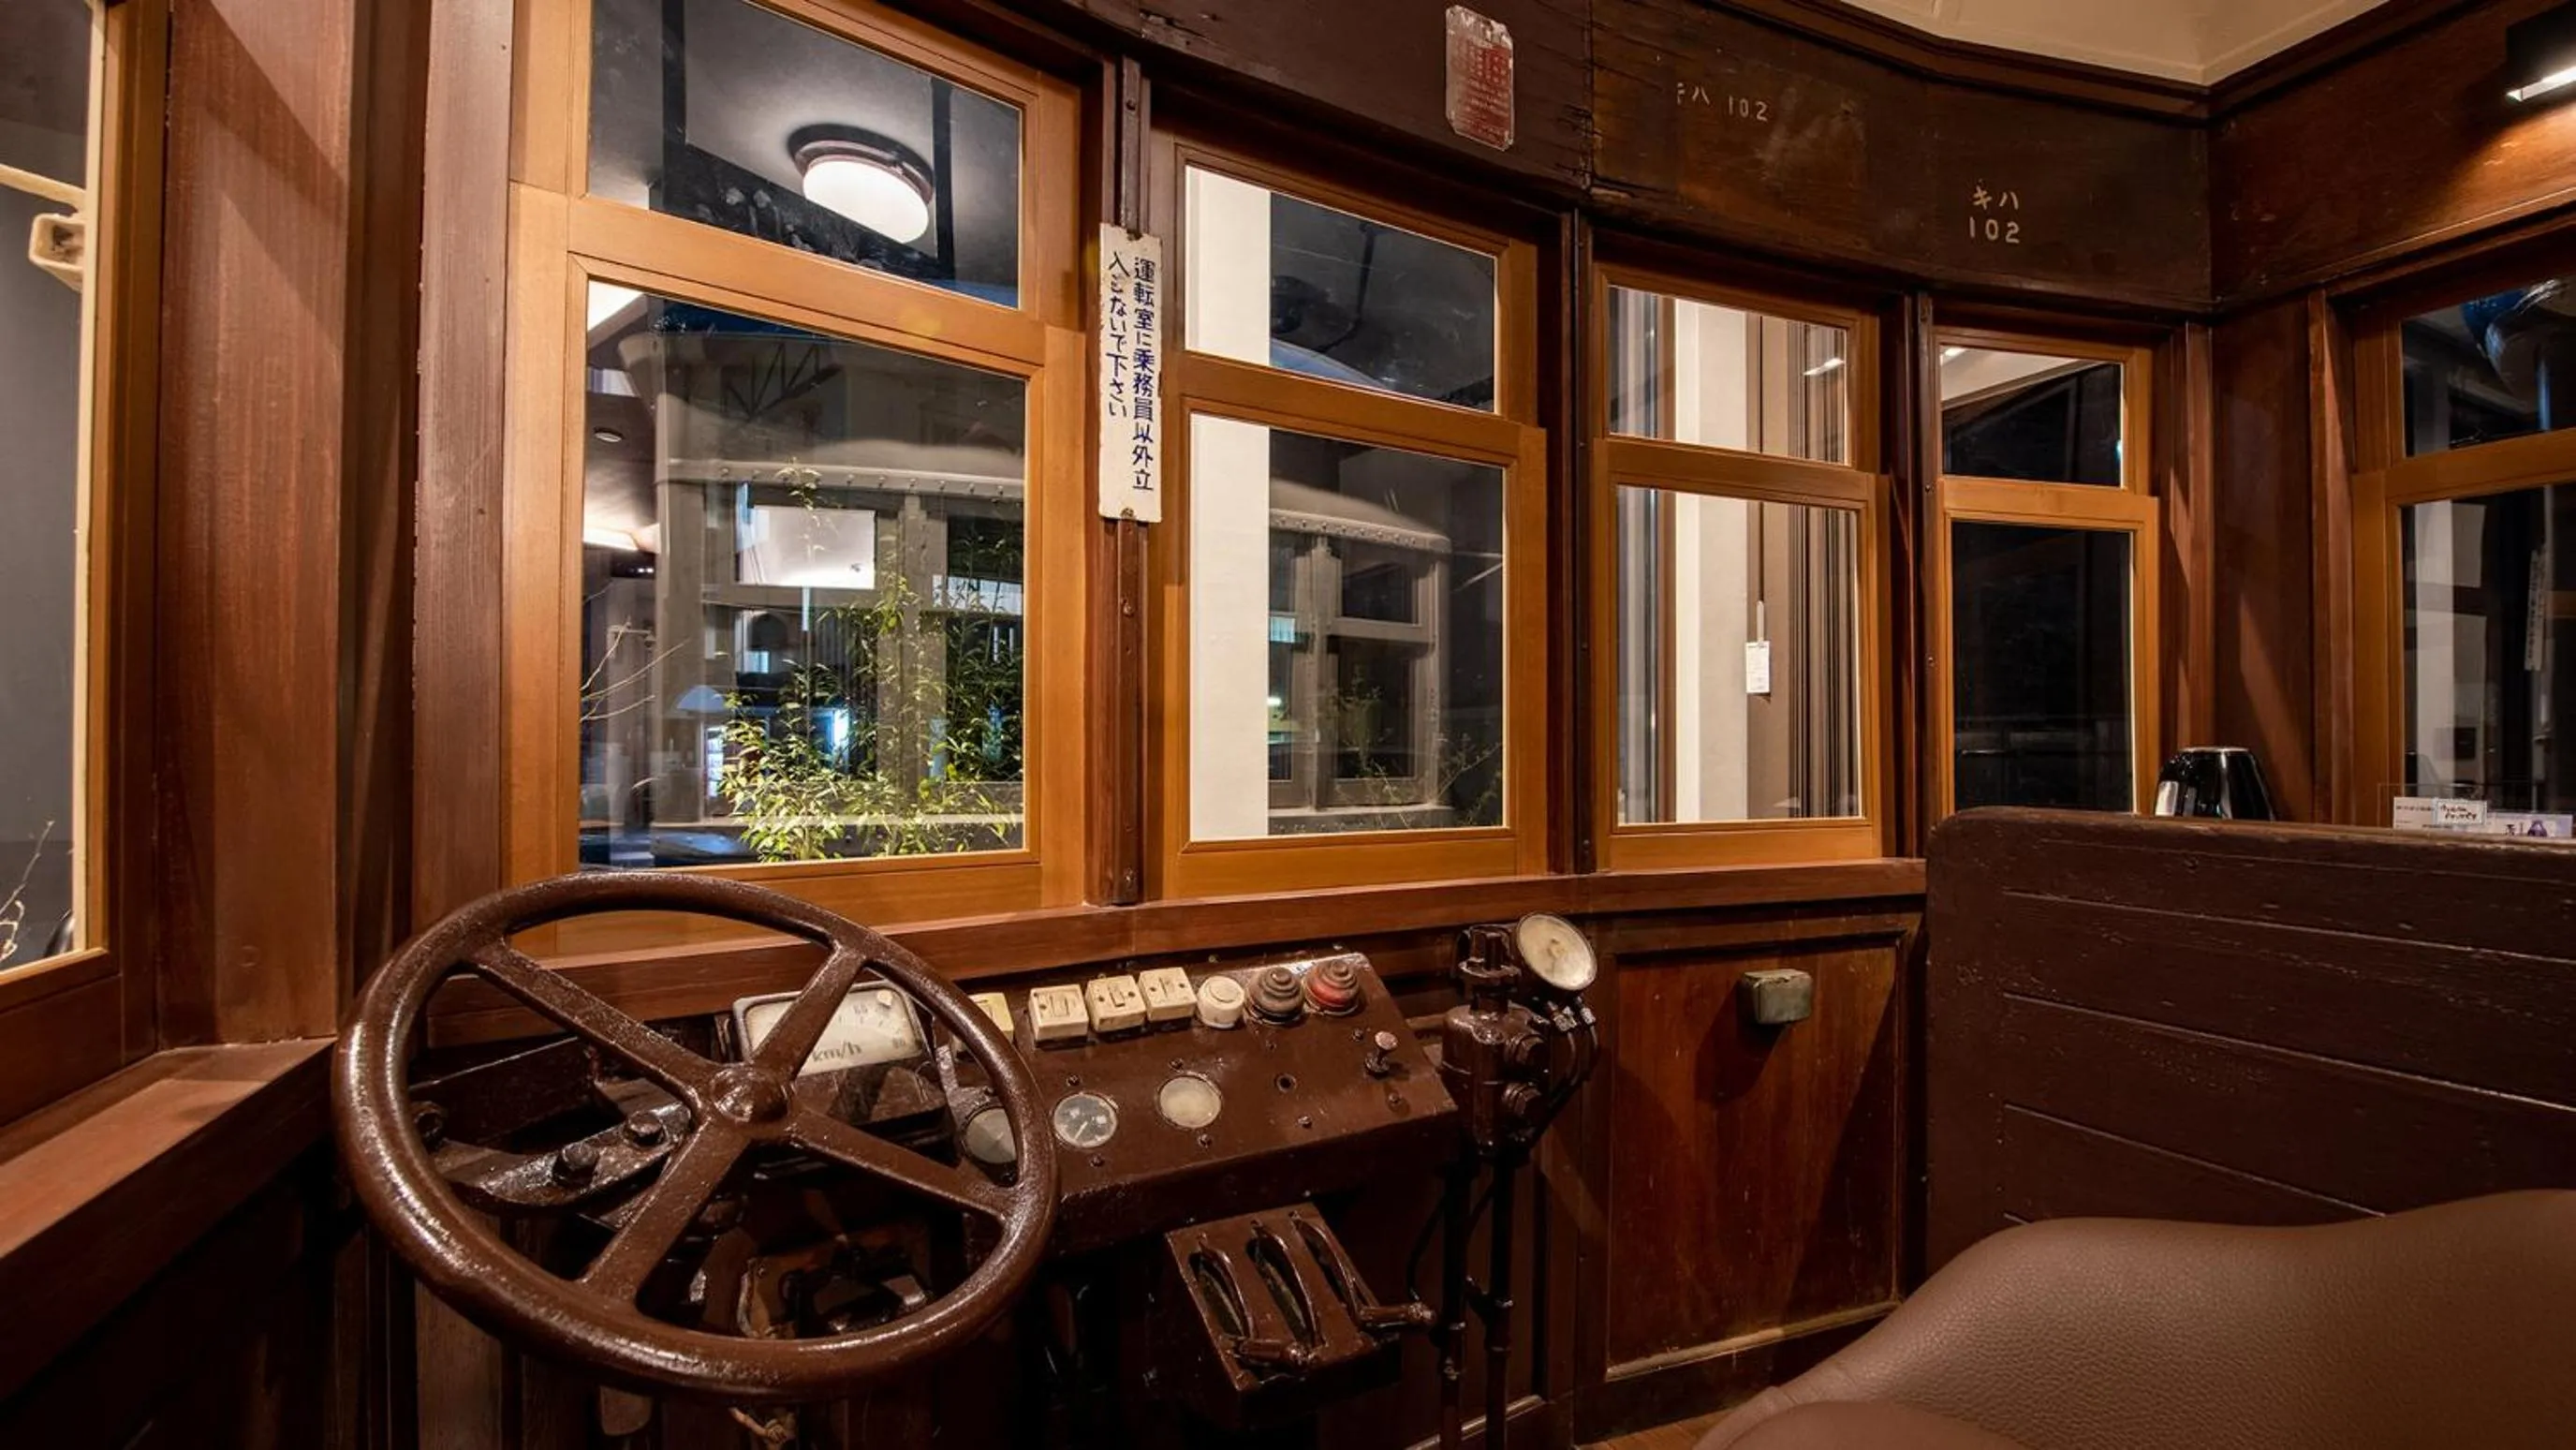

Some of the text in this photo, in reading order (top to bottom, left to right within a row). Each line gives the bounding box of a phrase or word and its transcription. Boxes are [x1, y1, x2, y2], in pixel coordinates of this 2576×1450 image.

[1728, 95, 1768, 122] 102
[1973, 185, 2020, 211] キハ
[1969, 215, 2020, 244] 102
[1132, 256, 1156, 492] 運転室に乗務員以外立
[812, 1040, 862, 1063] km/h
